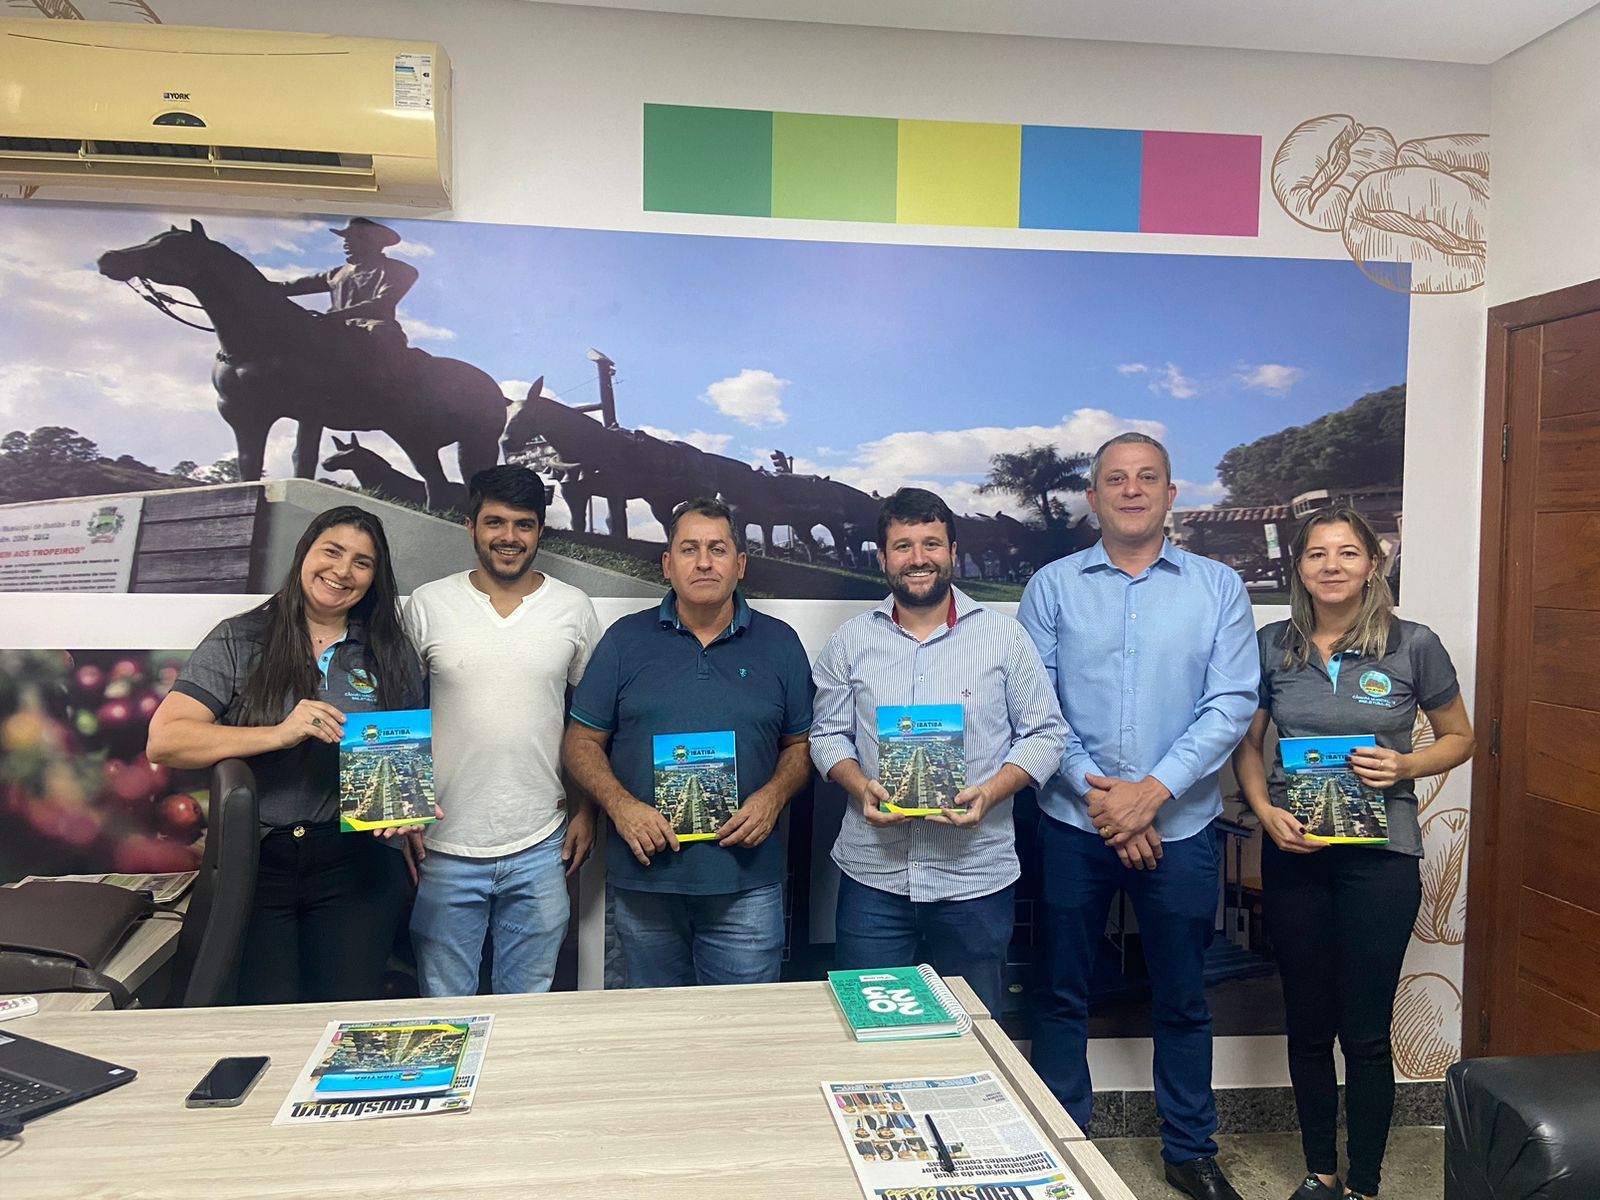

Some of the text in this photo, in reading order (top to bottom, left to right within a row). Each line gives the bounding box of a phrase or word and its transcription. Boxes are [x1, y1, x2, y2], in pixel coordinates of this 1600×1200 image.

[169, 92, 191, 100] YORK
[983, 1152, 1045, 1164] importantes
[993, 1157, 1049, 1169] legislatura
[920, 1167, 938, 1175] por
[932, 1162, 1052, 1180] Primeiro biênio da atual
[939, 1164, 984, 1173] marcao
